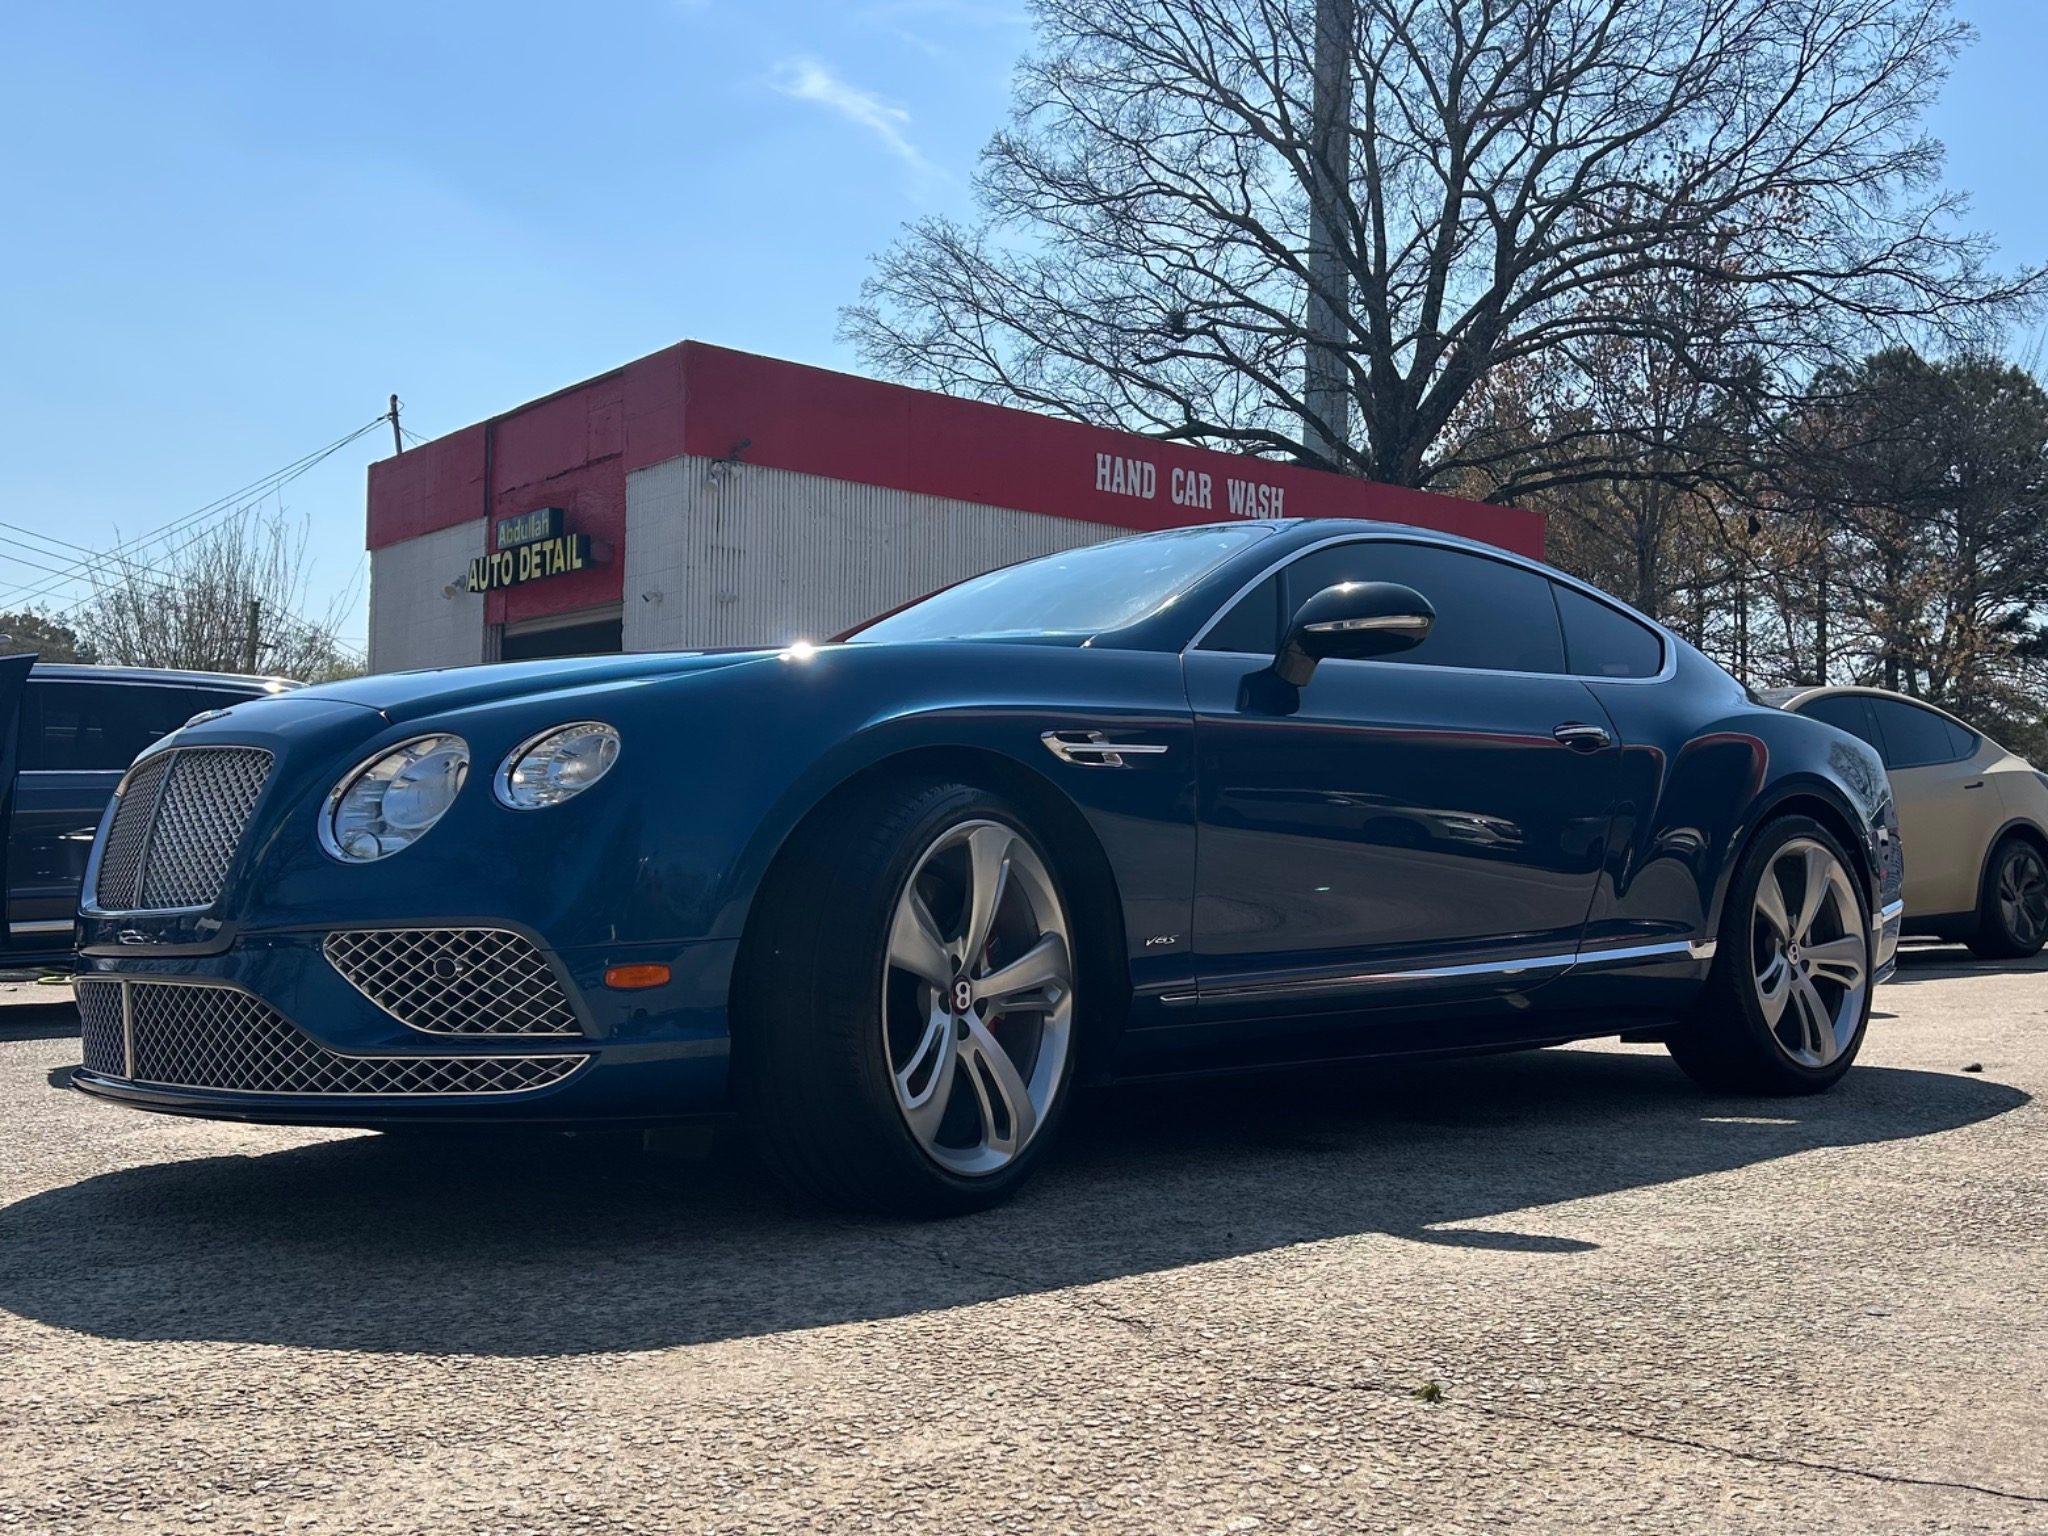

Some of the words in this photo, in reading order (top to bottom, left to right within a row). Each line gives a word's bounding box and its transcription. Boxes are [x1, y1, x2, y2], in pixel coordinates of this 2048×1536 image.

[1095, 453, 1156, 500] HAND
[1171, 467, 1212, 510] CAR
[1227, 478, 1285, 519] WASH
[498, 513, 550, 545] Abdullah
[467, 550, 514, 592] AUTO
[519, 533, 583, 582] DETAIL
